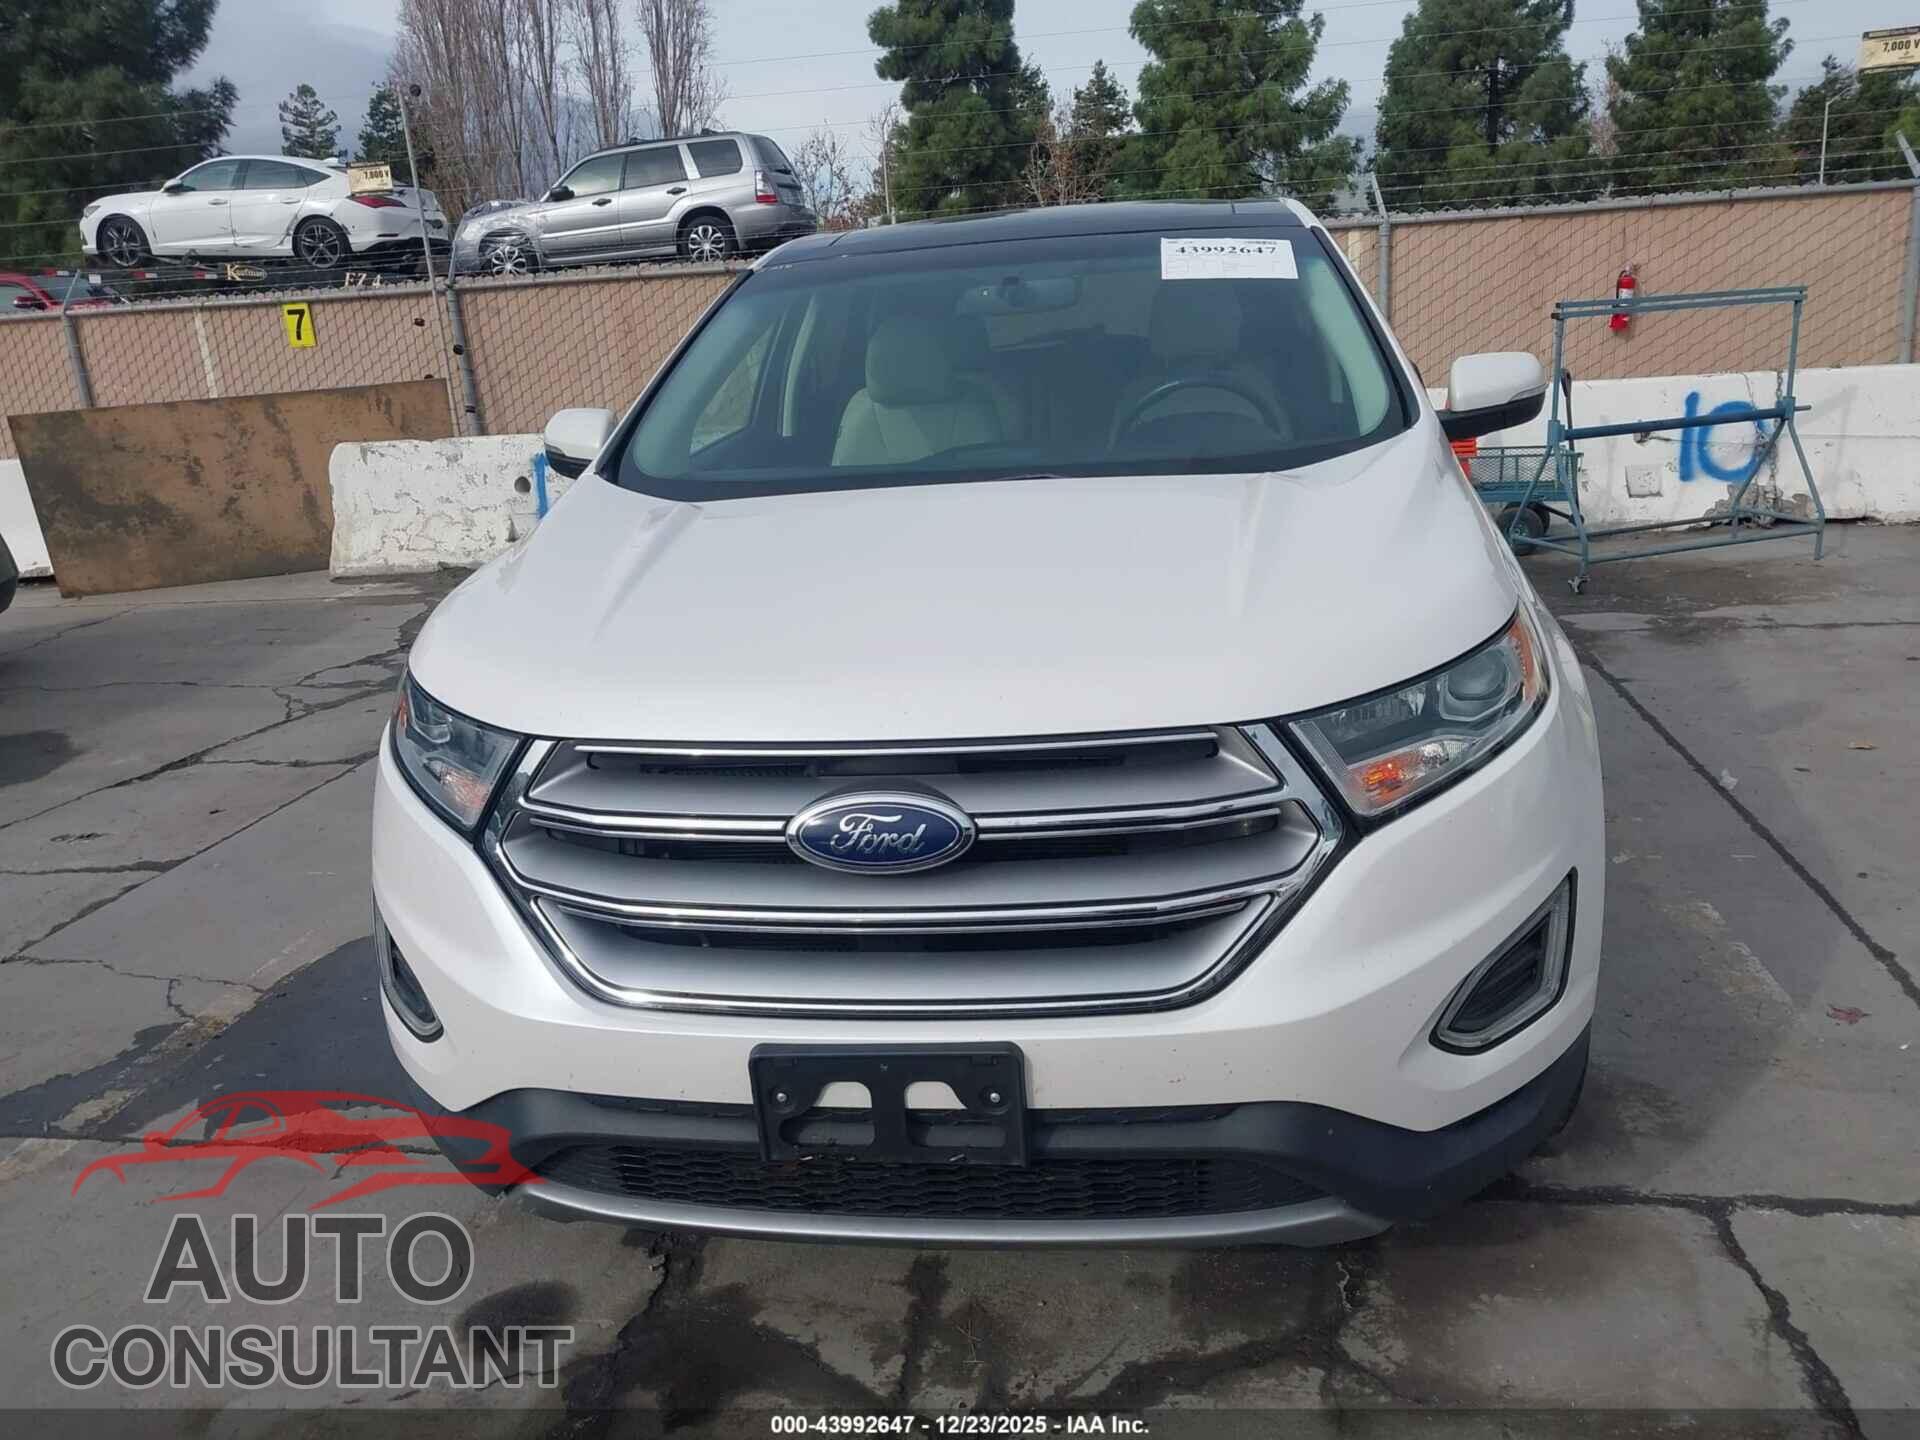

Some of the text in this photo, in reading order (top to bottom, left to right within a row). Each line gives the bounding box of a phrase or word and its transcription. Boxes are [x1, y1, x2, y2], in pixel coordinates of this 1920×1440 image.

[1882, 40, 1911, 52] 7,000
[1175, 245, 1277, 256] 43992647
[224, 263, 265, 281] Kaufman
[286, 308, 306, 341] 7
[1679, 391, 1774, 482] 10
[830, 812, 927, 853] Ford
